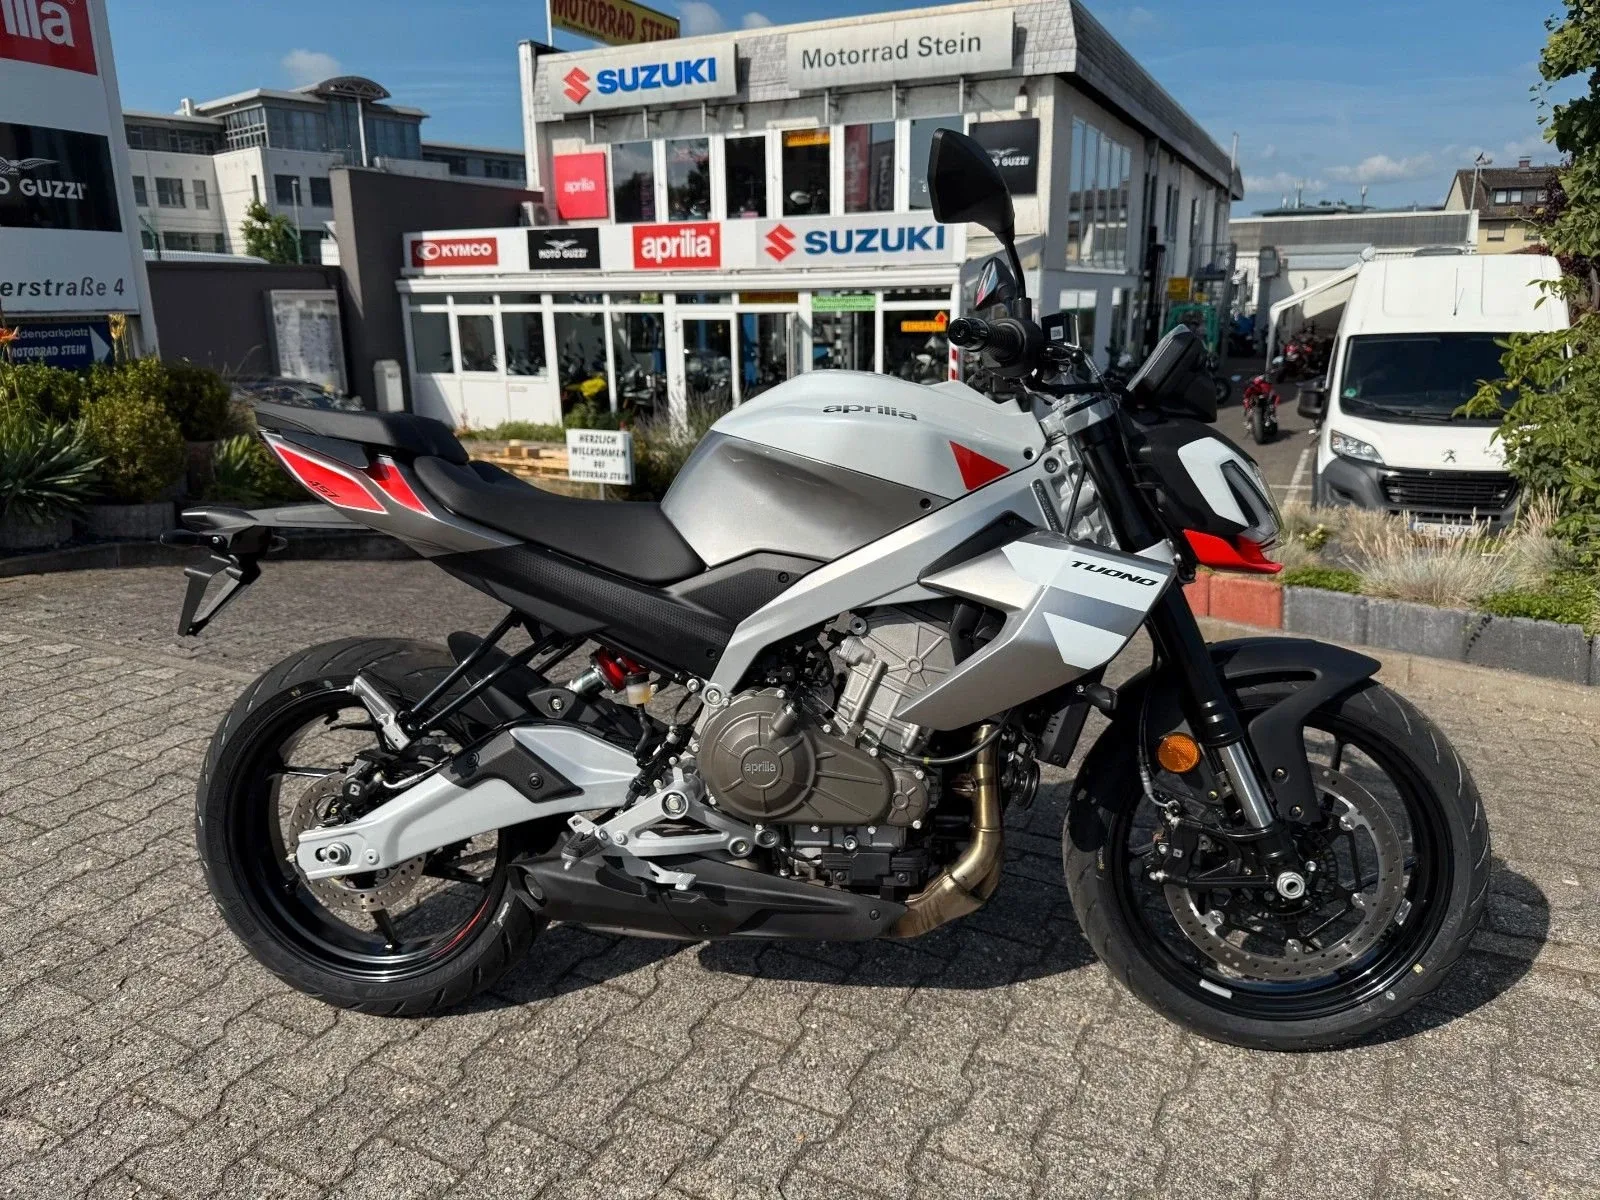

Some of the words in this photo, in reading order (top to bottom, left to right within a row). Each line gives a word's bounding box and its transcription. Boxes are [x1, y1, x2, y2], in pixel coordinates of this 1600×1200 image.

[801, 39, 908, 70] Motorrad
[917, 32, 982, 57] Stein
[597, 57, 717, 95] SUZUKI
[19, 179, 84, 200] GUZZI
[564, 178, 595, 193] aprilia
[641, 229, 712, 263] aprilia
[804, 226, 945, 255] SUZUKI
[441, 242, 492, 257] KYMCO
[538, 249, 562, 260] MOTO
[562, 248, 588, 259] GUZZI
[0, 276, 107, 297] erstraße
[113, 278, 125, 296] 4
[18, 328, 88, 339] denparkplatz
[61, 345, 86, 355] STEIN
[823, 405, 917, 421] aprilia
[579, 433, 616, 444] HERZLICH
[572, 447, 626, 457] WILLKOMMEN
[572, 470, 608, 480] MOTORRAD
[308, 480, 340, 498] 457
[1071, 560, 1159, 587] TUONO
[745, 760, 777, 774] aprilia
